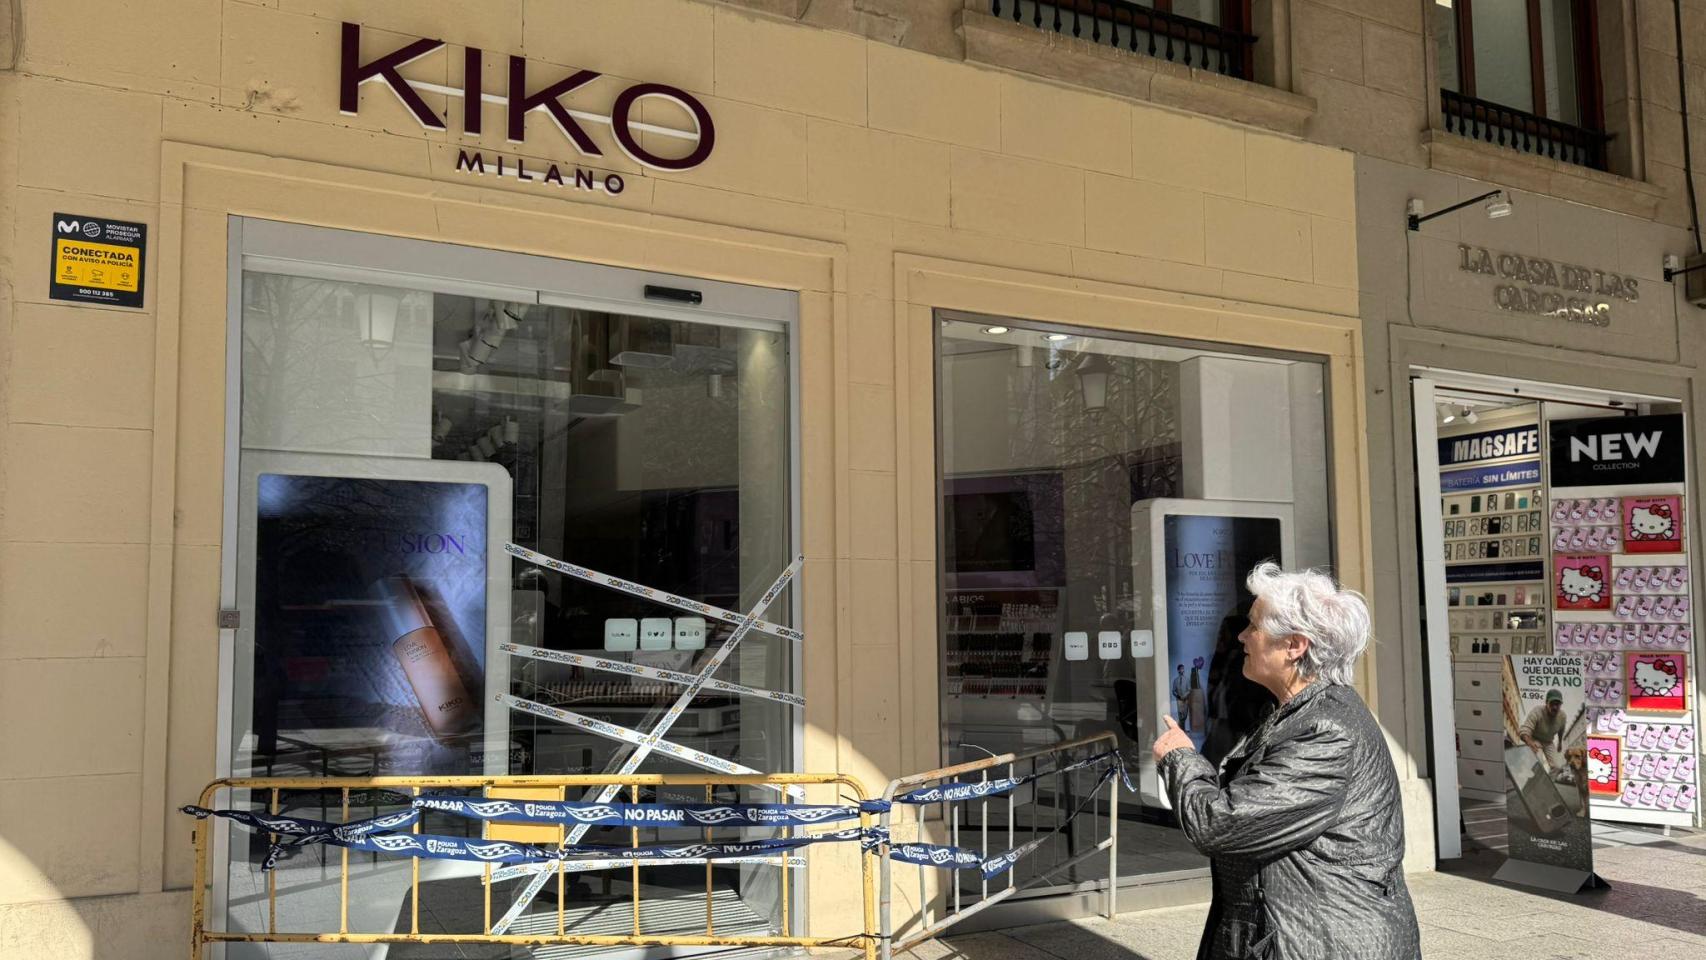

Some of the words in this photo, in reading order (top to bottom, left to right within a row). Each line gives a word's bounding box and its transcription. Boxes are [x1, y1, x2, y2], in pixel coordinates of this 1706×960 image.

[340, 22, 715, 171] KIKO
[456, 150, 625, 195] MILANO
[106, 224, 138, 232] MOVISTAR
[106, 229, 141, 238] PROSEGUR
[62, 246, 134, 262] CONECTADA
[79, 256, 100, 264] AVISO
[1458, 242, 1496, 276] LA
[1498, 254, 1560, 288] CASA
[1561, 263, 1593, 293] DE
[1594, 269, 1640, 302] LAS
[1453, 430, 1538, 462] MAGSAFE
[1570, 430, 1663, 462] NEW
[1593, 462, 1640, 471] COLLECTION
[1482, 473, 1499, 483] SIN
[1500, 469, 1539, 481] LÍMITES
[1175, 548, 1215, 569] LOVE
[1523, 657, 1545, 665] HAY
[1522, 666, 1541, 675] QUE
[1543, 667, 1582, 677] DUELEN,
[1528, 676, 1560, 687] ESTA
[1563, 676, 1582, 687] NO
[425, 799, 464, 811] PASAR
[534, 809, 567, 819] Zaragoza
[624, 808, 644, 820] NO
[646, 808, 684, 821] PASAR
[757, 814, 789, 822] Zaragoza
[436, 846, 467, 856] Zaragoza
